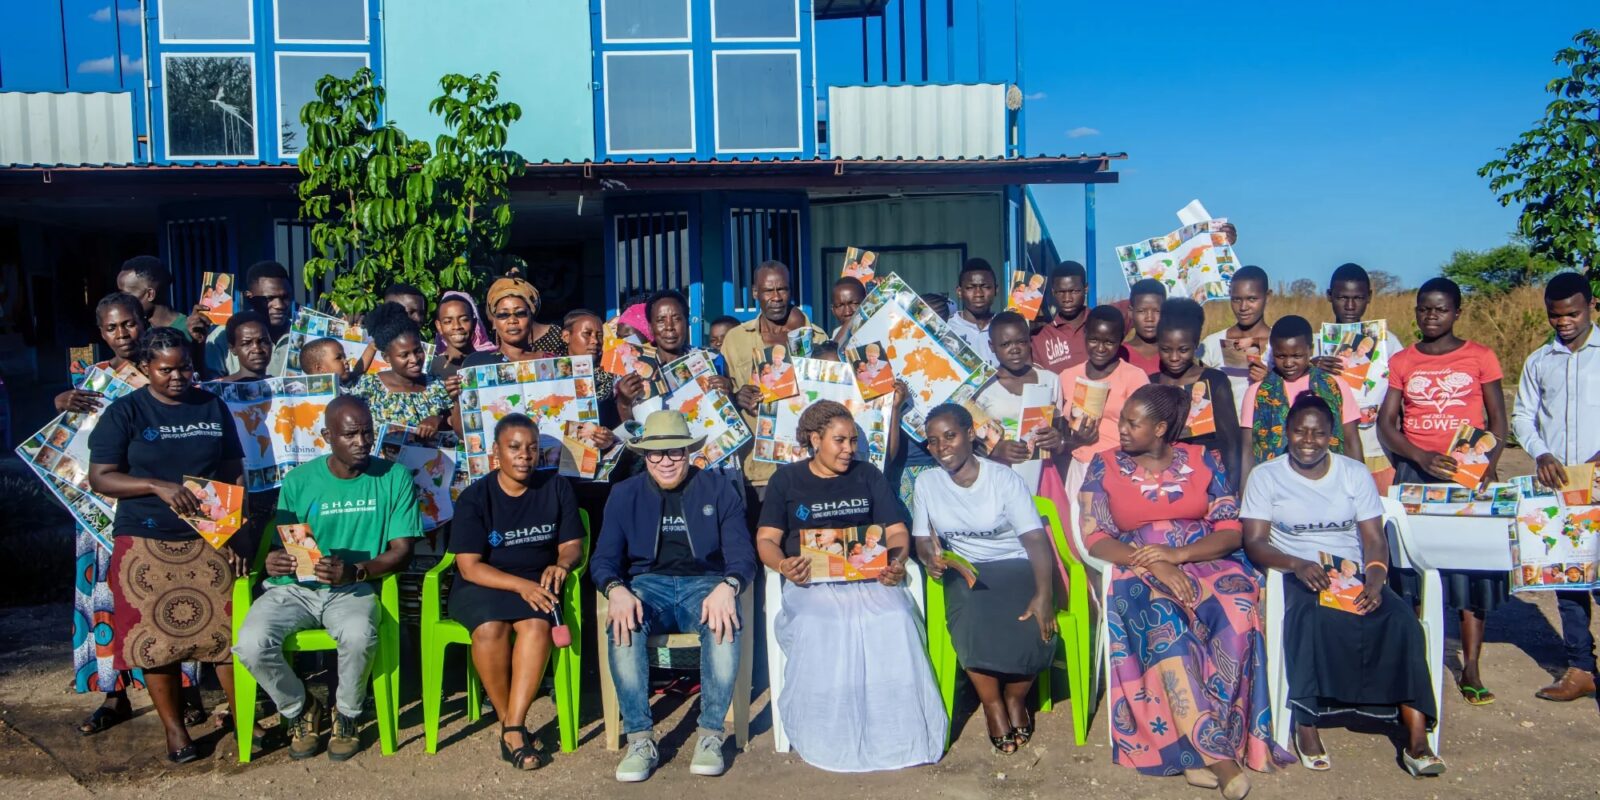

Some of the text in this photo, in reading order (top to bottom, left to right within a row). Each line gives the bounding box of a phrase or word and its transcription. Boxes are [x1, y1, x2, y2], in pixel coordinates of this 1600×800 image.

[159, 421, 222, 433] SHADE
[321, 498, 376, 510] SHADE
[811, 498, 869, 512] SHADE
[1293, 519, 1353, 531] SHAD
